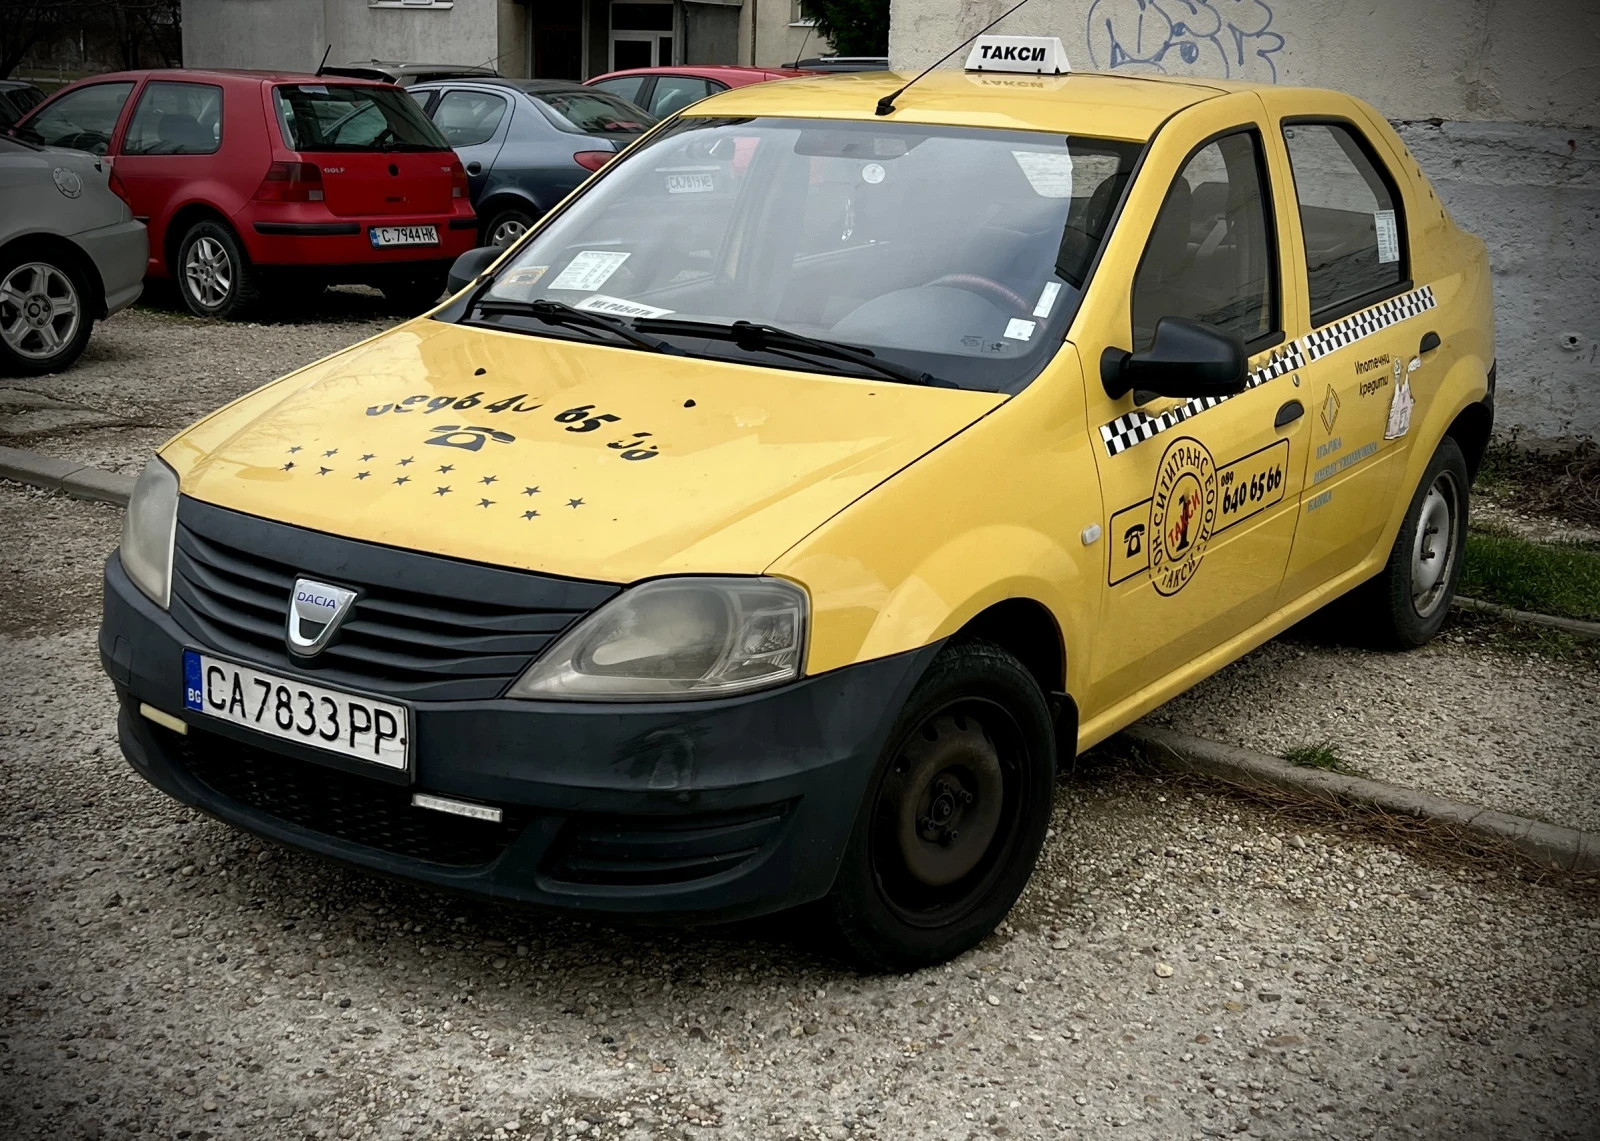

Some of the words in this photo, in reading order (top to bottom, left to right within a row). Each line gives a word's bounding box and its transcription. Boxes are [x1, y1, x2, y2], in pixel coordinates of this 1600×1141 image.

[980, 45, 1046, 62] ТАКСИ
[1354, 353, 1390, 375] Ипотечни
[1359, 375, 1389, 398] кредити
[553, 404, 622, 433] 65
[1221, 471, 1234, 487] 089
[1223, 482, 1247, 515] 640
[1168, 489, 1200, 548] ТАКСИ
[297, 591, 337, 609] DACIA
[188, 687, 202, 704] BG
